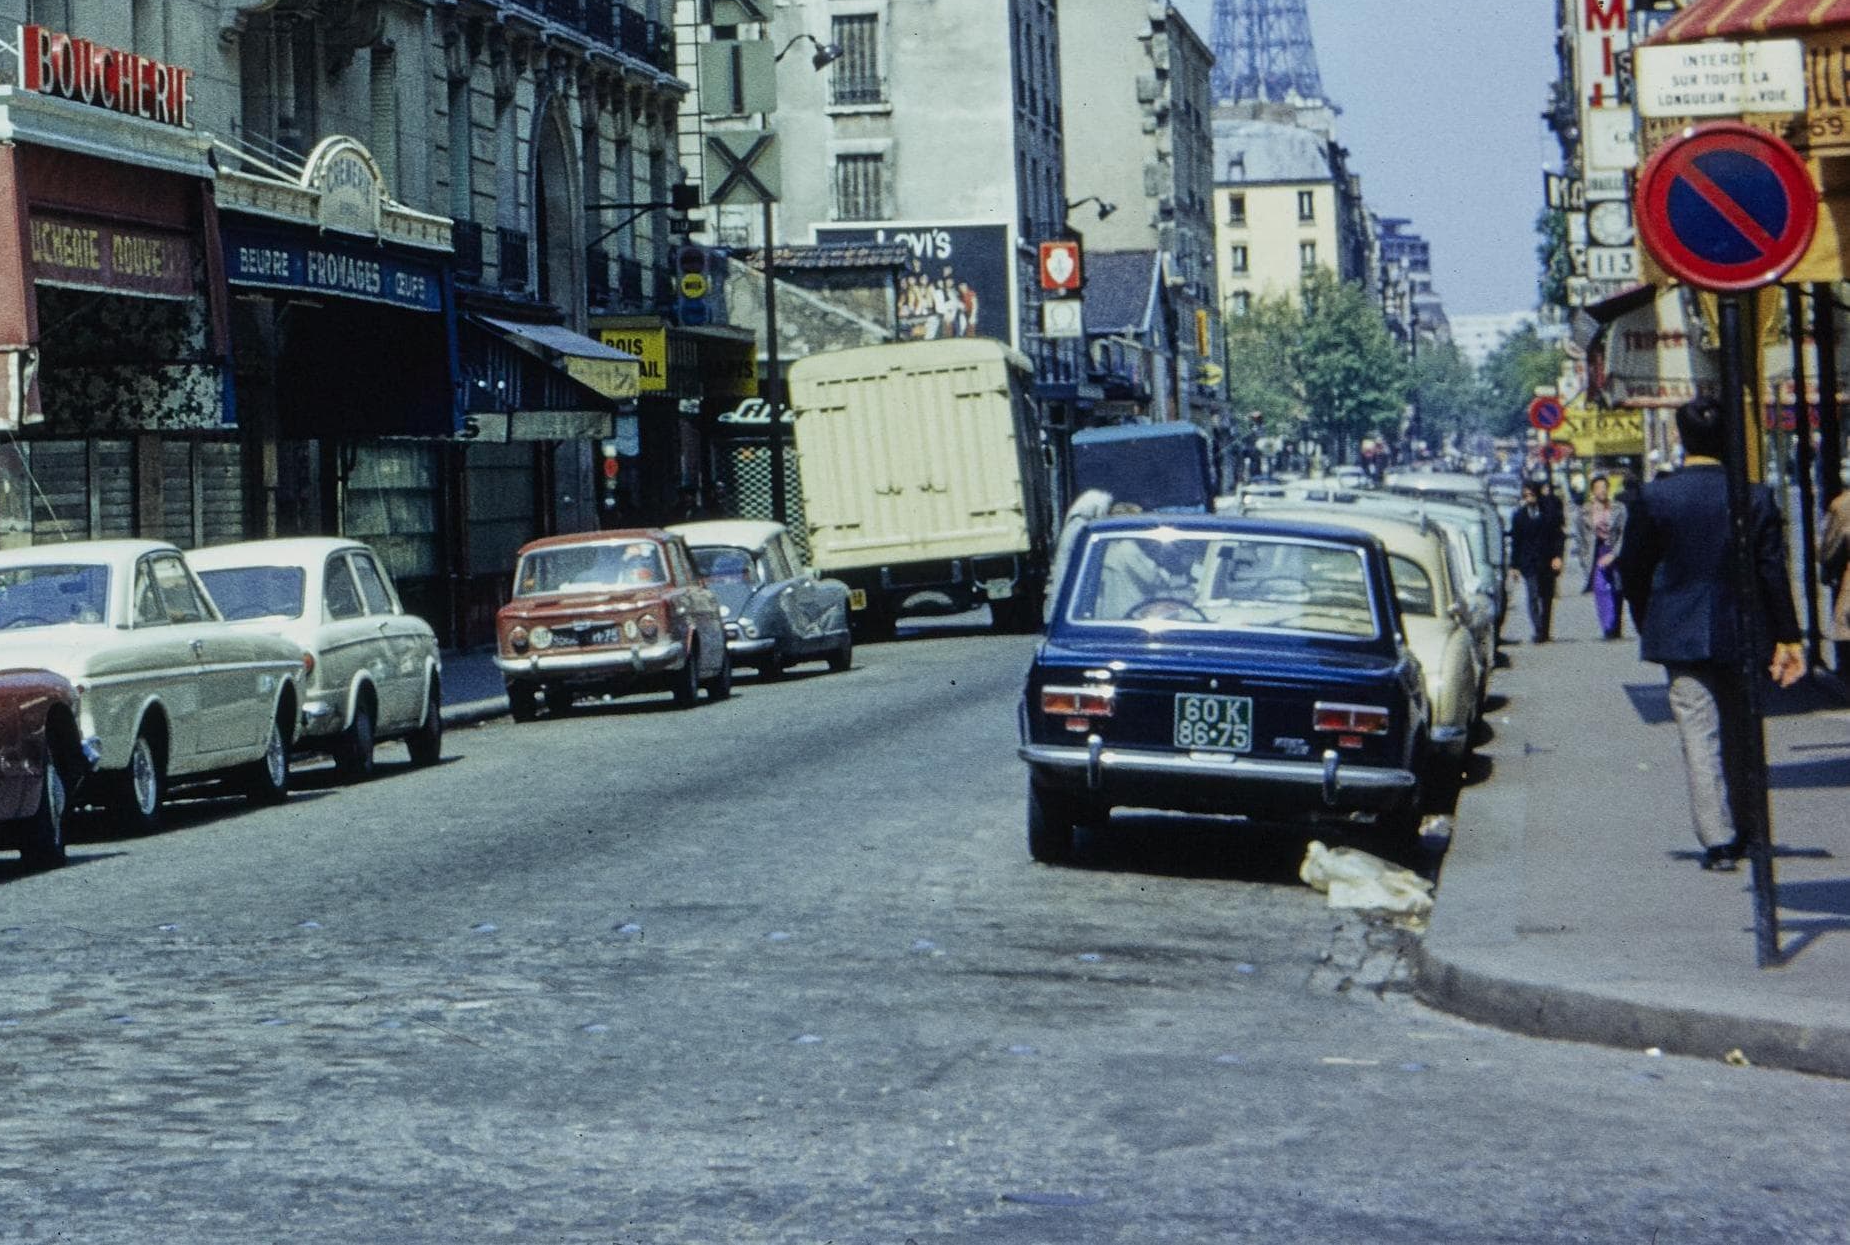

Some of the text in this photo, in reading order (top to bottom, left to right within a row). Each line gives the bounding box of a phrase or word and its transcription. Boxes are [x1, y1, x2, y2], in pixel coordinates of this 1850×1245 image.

[1682, 52, 1756, 67] INTERDIT
[25, 25, 196, 130] BOUCHERIE
[1671, 71, 1770, 87] SUR TOUTE LA
[1657, 92, 1725, 107] LONGUEUR
[1759, 89, 1787, 102] VOIE
[1184, 698, 1242, 724] 60 K
